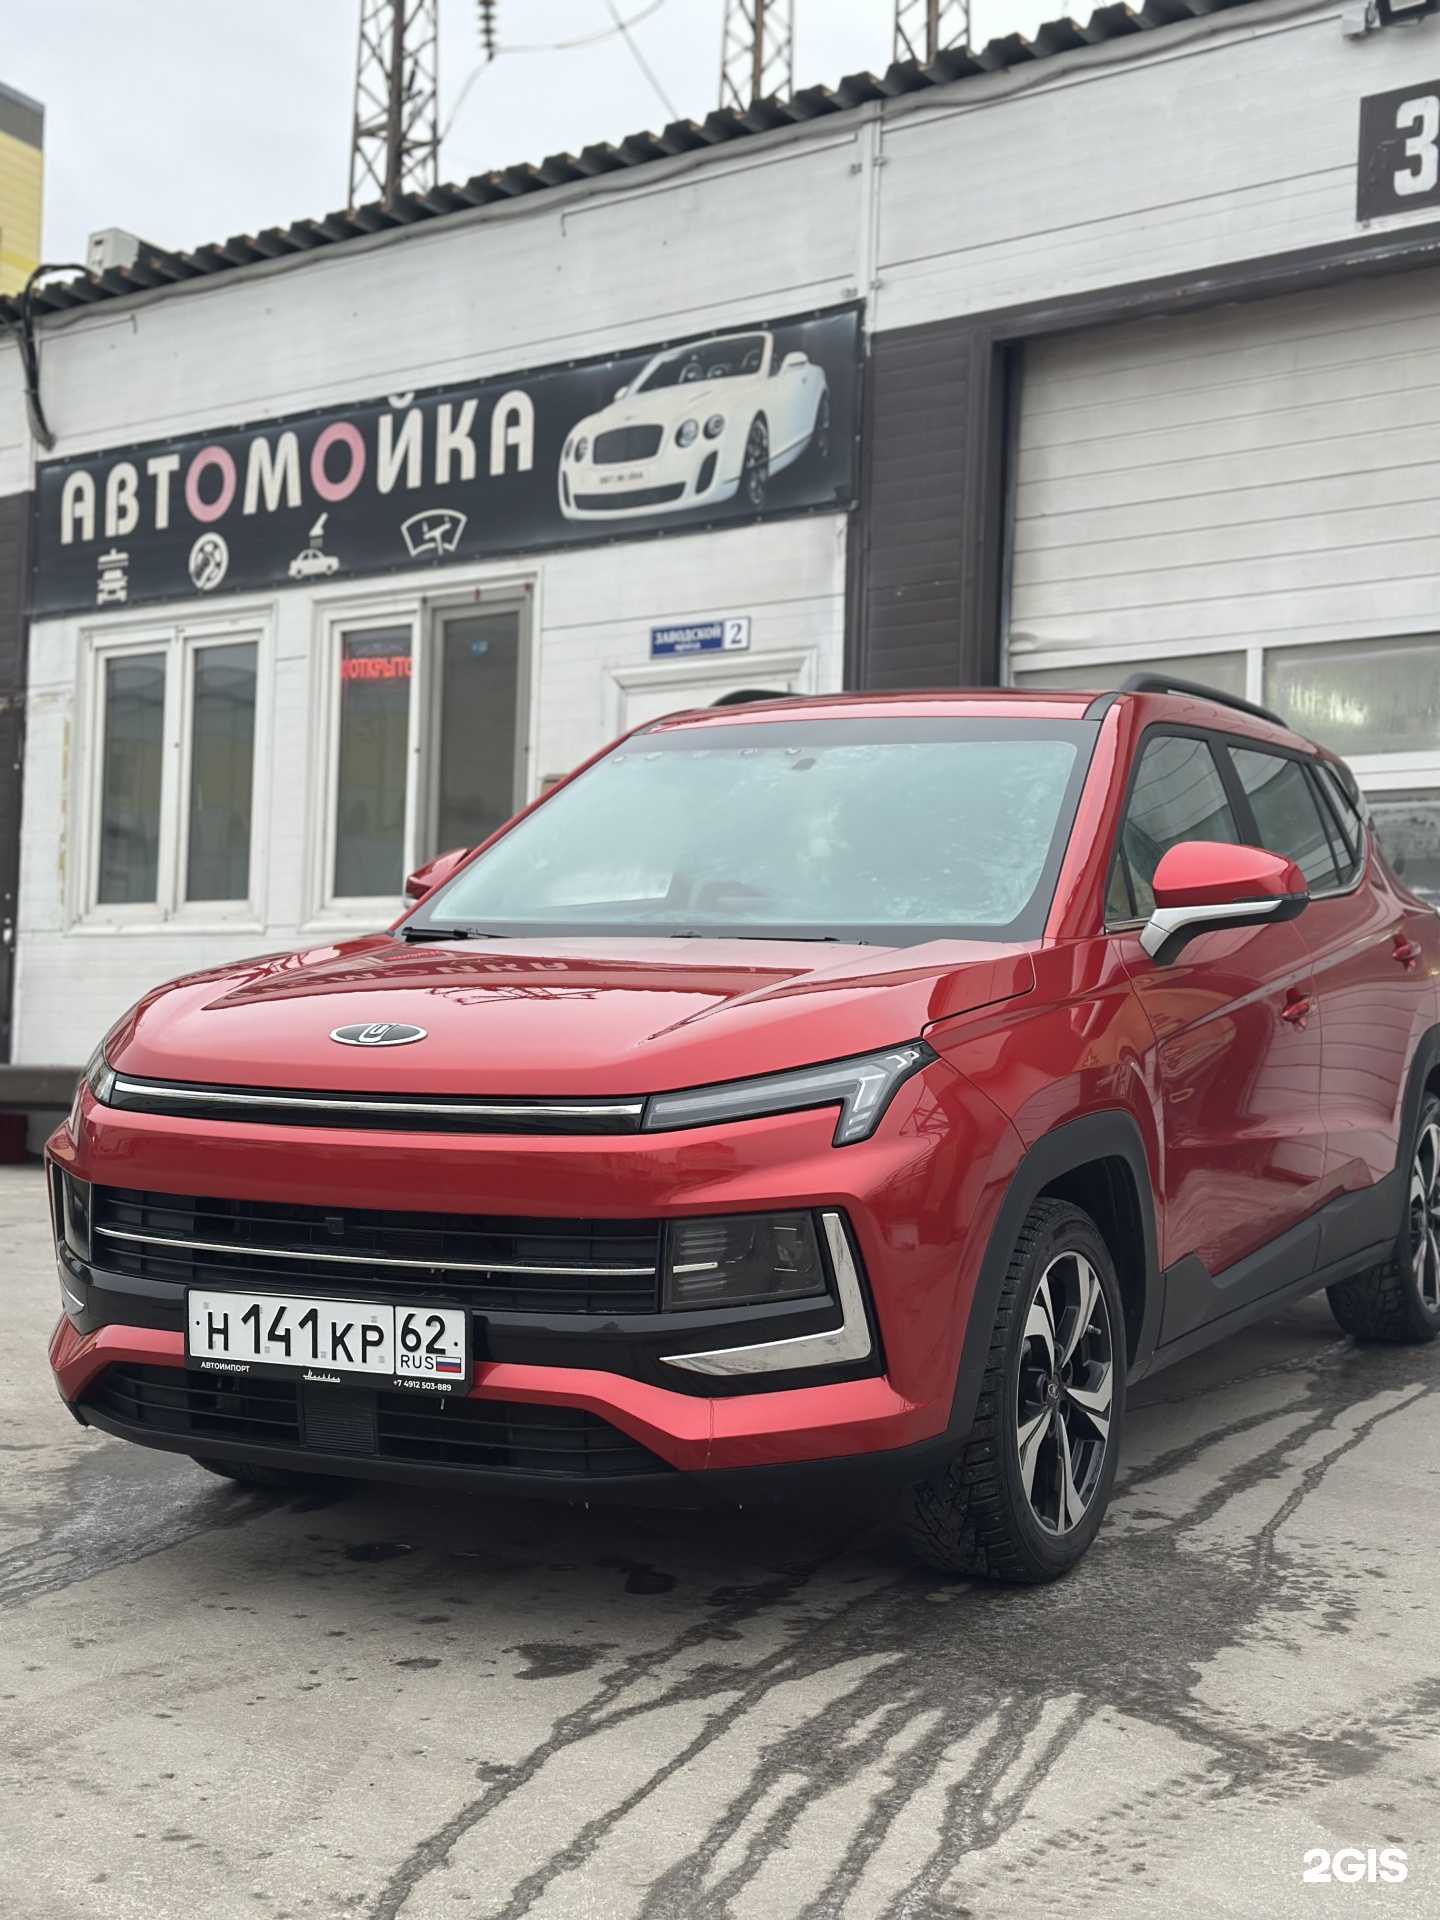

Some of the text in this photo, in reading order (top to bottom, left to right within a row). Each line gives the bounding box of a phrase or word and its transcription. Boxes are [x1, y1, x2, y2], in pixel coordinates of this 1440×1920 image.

[59, 390, 536, 544] АВТОМОЙКА
[730, 622, 743, 649] 2
[400, 1313, 447, 1356] 62
[200, 1361, 251, 1373] АВТОИМПОРТ
[400, 1354, 435, 1371] RUS
[393, 1379, 402, 1387] +7
[403, 1380, 421, 1389] 4912
